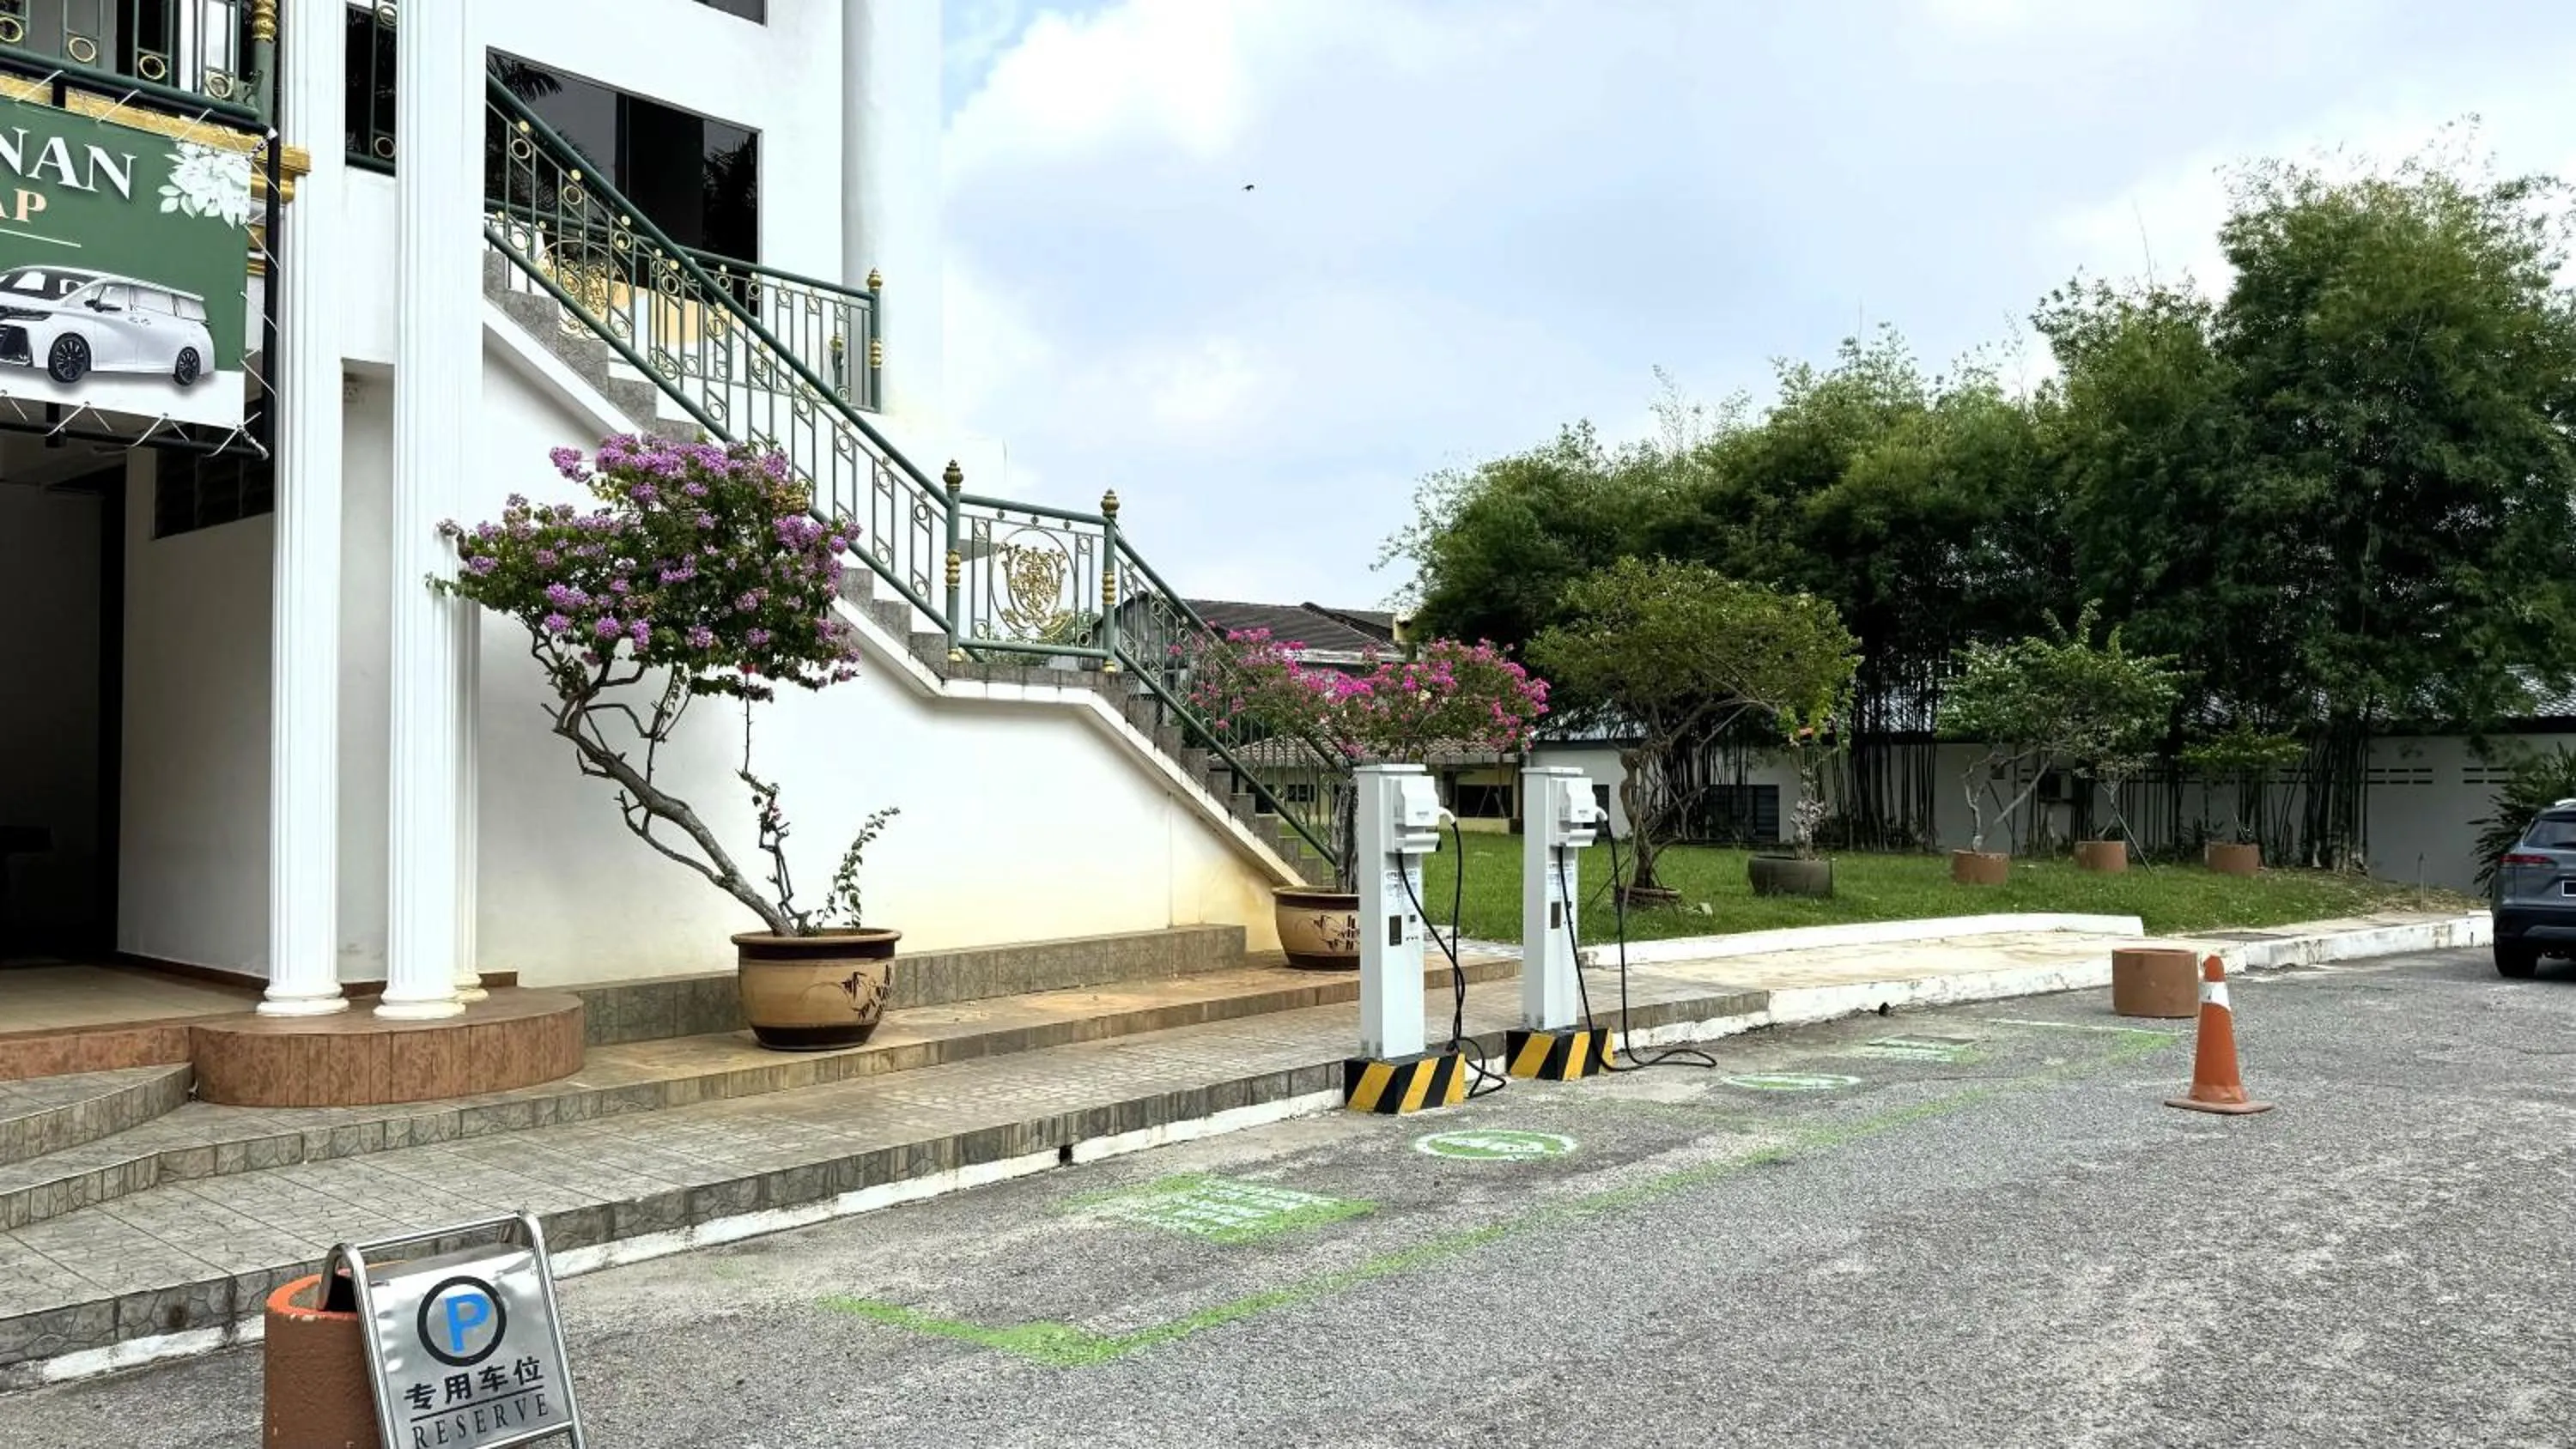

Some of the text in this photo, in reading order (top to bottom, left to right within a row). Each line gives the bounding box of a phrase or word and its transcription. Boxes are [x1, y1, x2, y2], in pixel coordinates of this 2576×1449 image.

[445, 1294, 490, 1352] P
[404, 1355, 544, 1410] 专用车位
[412, 1393, 549, 1449] RESERVE
